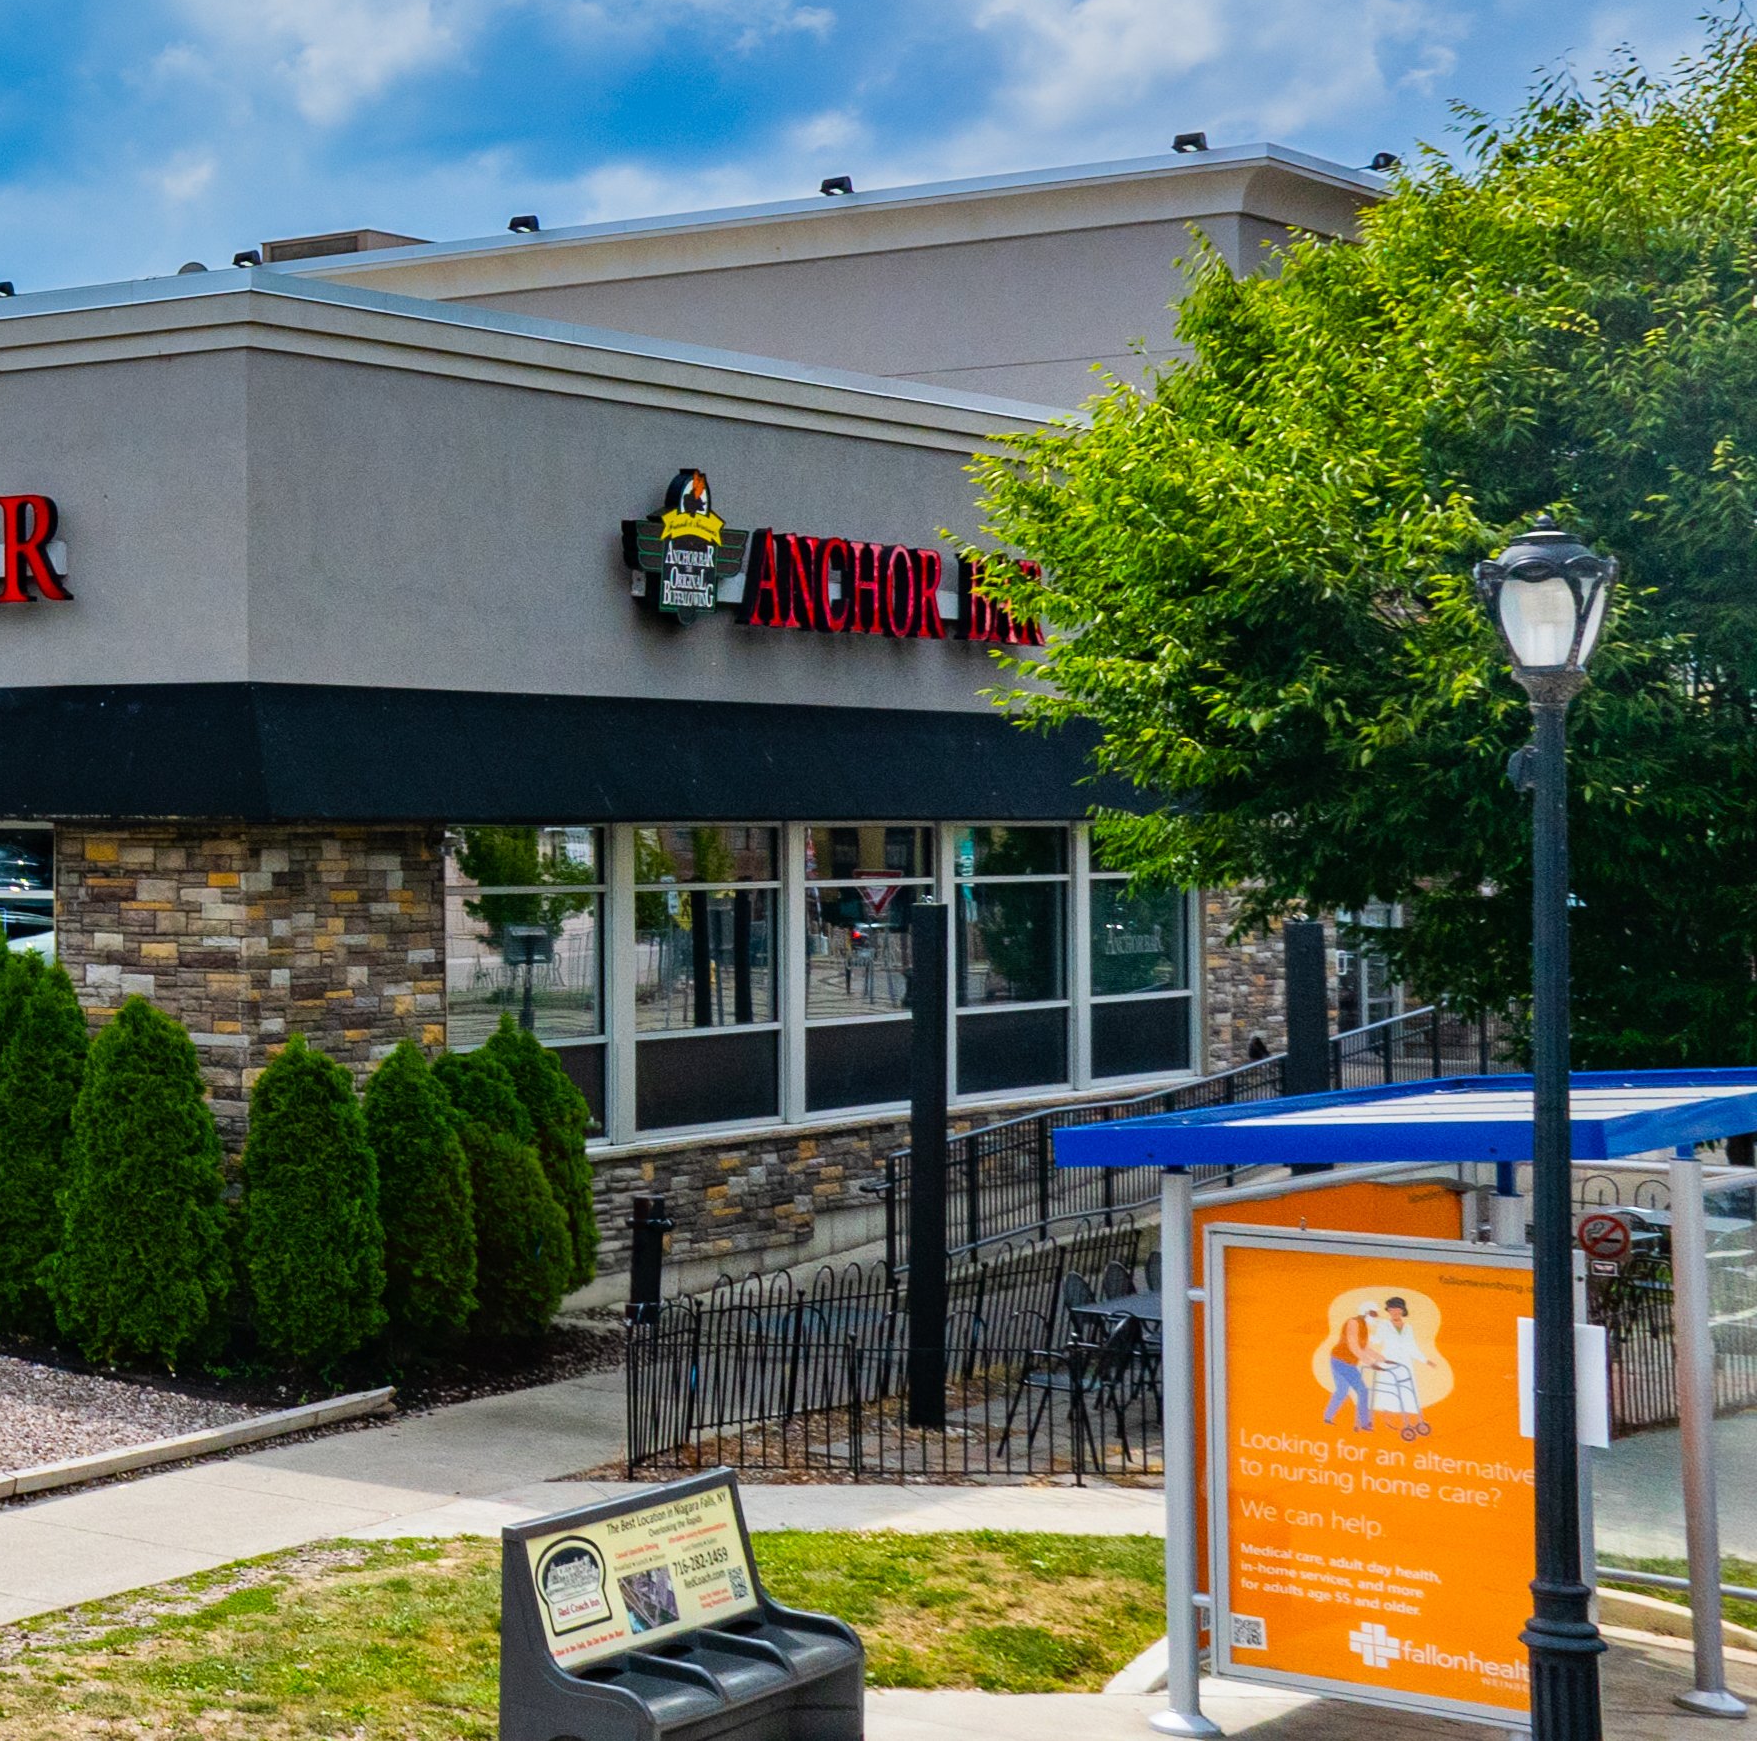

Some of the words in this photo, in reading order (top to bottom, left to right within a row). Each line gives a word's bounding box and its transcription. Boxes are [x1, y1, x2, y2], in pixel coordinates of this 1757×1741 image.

[741, 527, 946, 640] ANCHOR
[1240, 1428, 1329, 1462] Looking
[1336, 1438, 1369, 1462] for
[1375, 1448, 1406, 1468] an
[1413, 1451, 1535, 1486] alternative
[1239, 1456, 1263, 1477] to
[1270, 1463, 1355, 1495] nursing
[1361, 1470, 1431, 1499] home
[1438, 1484, 1502, 1508] care?
[606, 1522, 620, 1536] The
[620, 1518, 636, 1532] Best
[637, 1511, 666, 1528] Location
[673, 1501, 699, 1516] Niagara
[700, 1494, 717, 1508] Falls,
[716, 1490, 727, 1504] NY
[1239, 1498, 1278, 1521] We
[1284, 1509, 1324, 1530] can
[1330, 1510, 1387, 1540] help.
[672, 1546, 728, 1577] 716-282-1459
[1240, 1542, 1293, 1560] Medical
[1295, 1552, 1326, 1567] care,
[1329, 1556, 1364, 1572] adult
[1367, 1561, 1392, 1577] day
[1395, 1565, 1442, 1585] health,
[1240, 1561, 1297, 1580] in-home
[1299, 1570, 1354, 1589] services,
[1357, 1579, 1385, 1593] and
[1387, 1585, 1426, 1599] more
[557, 1606, 571, 1617] Red
[570, 1600, 590, 1614] Coach
[589, 1597, 601, 1608] Inn
[1240, 1577, 1259, 1591] for
[1262, 1581, 1305, 1598] adults
[1307, 1589, 1332, 1603] age
[1335, 1591, 1352, 1605] 55
[1354, 1596, 1381, 1610] and
[1383, 1600, 1422, 1616] older.
[1400, 1640, 1530, 1683] fallonhealt
